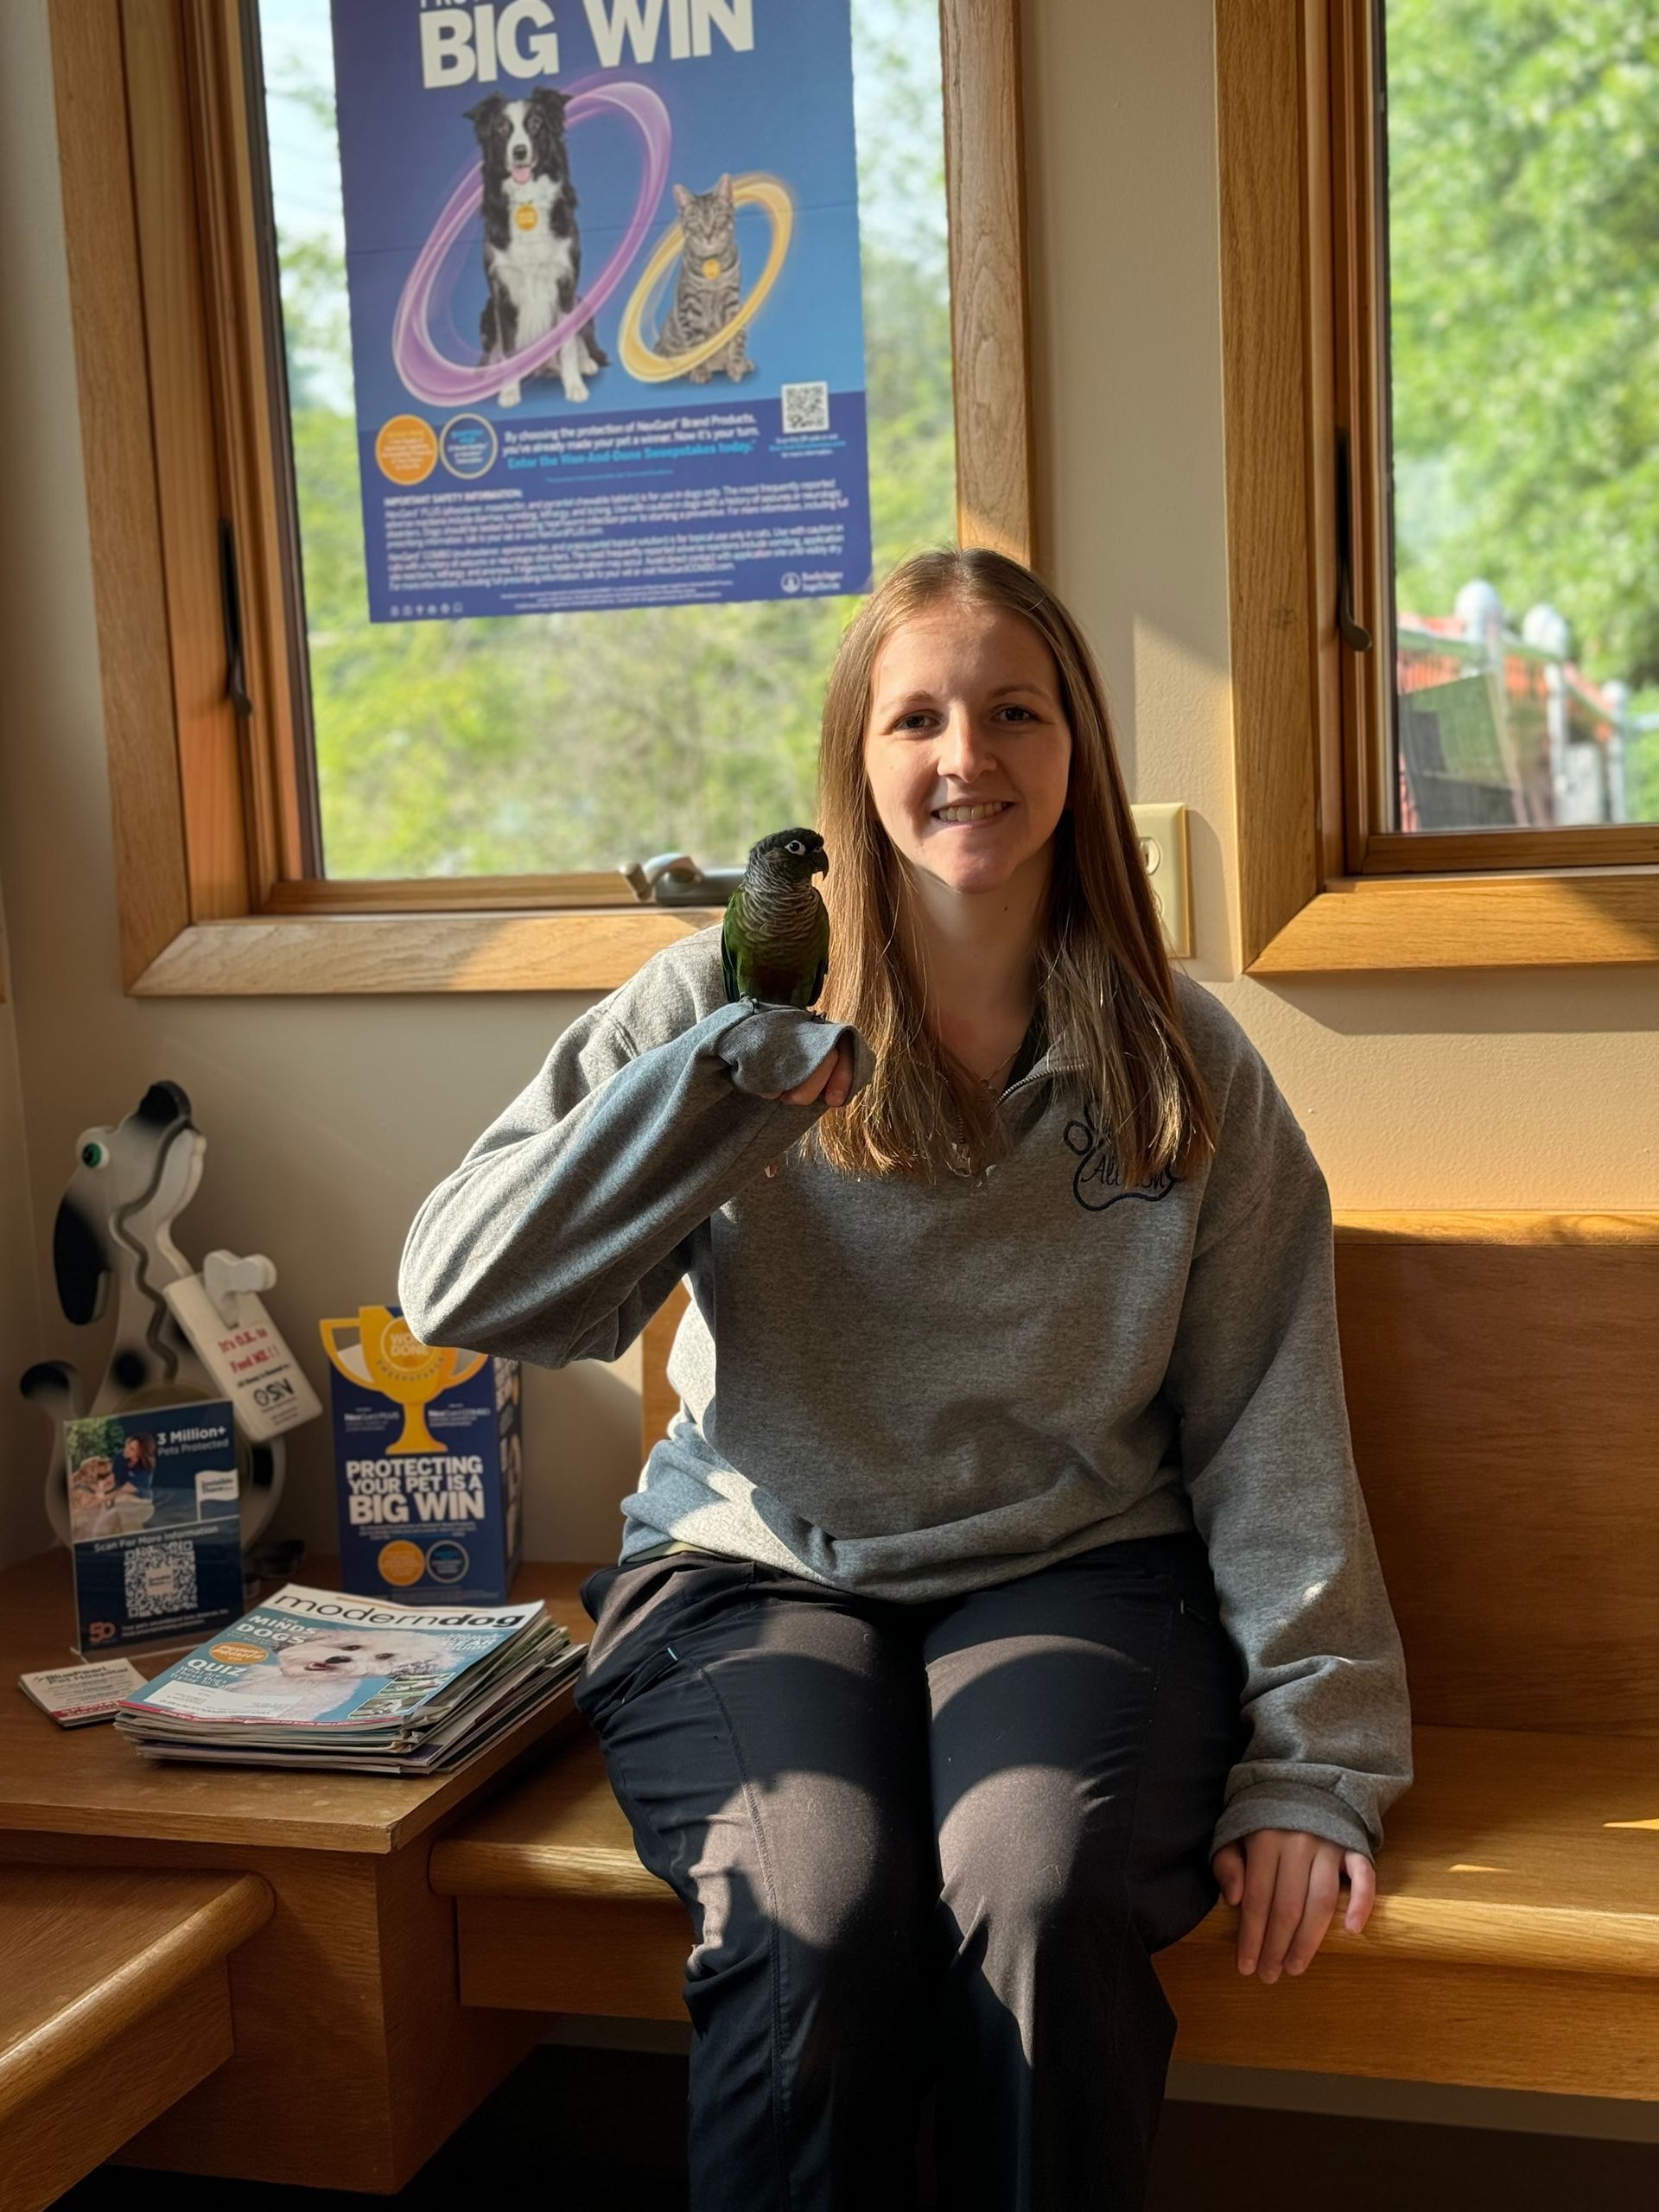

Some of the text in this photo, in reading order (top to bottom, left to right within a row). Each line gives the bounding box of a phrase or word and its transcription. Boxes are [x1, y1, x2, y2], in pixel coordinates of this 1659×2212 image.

[420, 0, 754, 88] BIG WIN
[156, 1426, 226, 1446] 3 Million+
[157, 1438, 230, 1457] Pets Protected
[346, 1455, 483, 1479] PROTECTING
[348, 1473, 483, 1496] YOUR PET IS A
[349, 1491, 485, 1525] BIG WIN
[93, 1541, 118, 1553] Scan
[138, 1534, 162, 1544] More
[163, 1525, 219, 1541] Information
[235, 1623, 308, 1644] DOGS
[249, 1615, 319, 1635] MINDS
[188, 1659, 247, 1677] QUIZ
